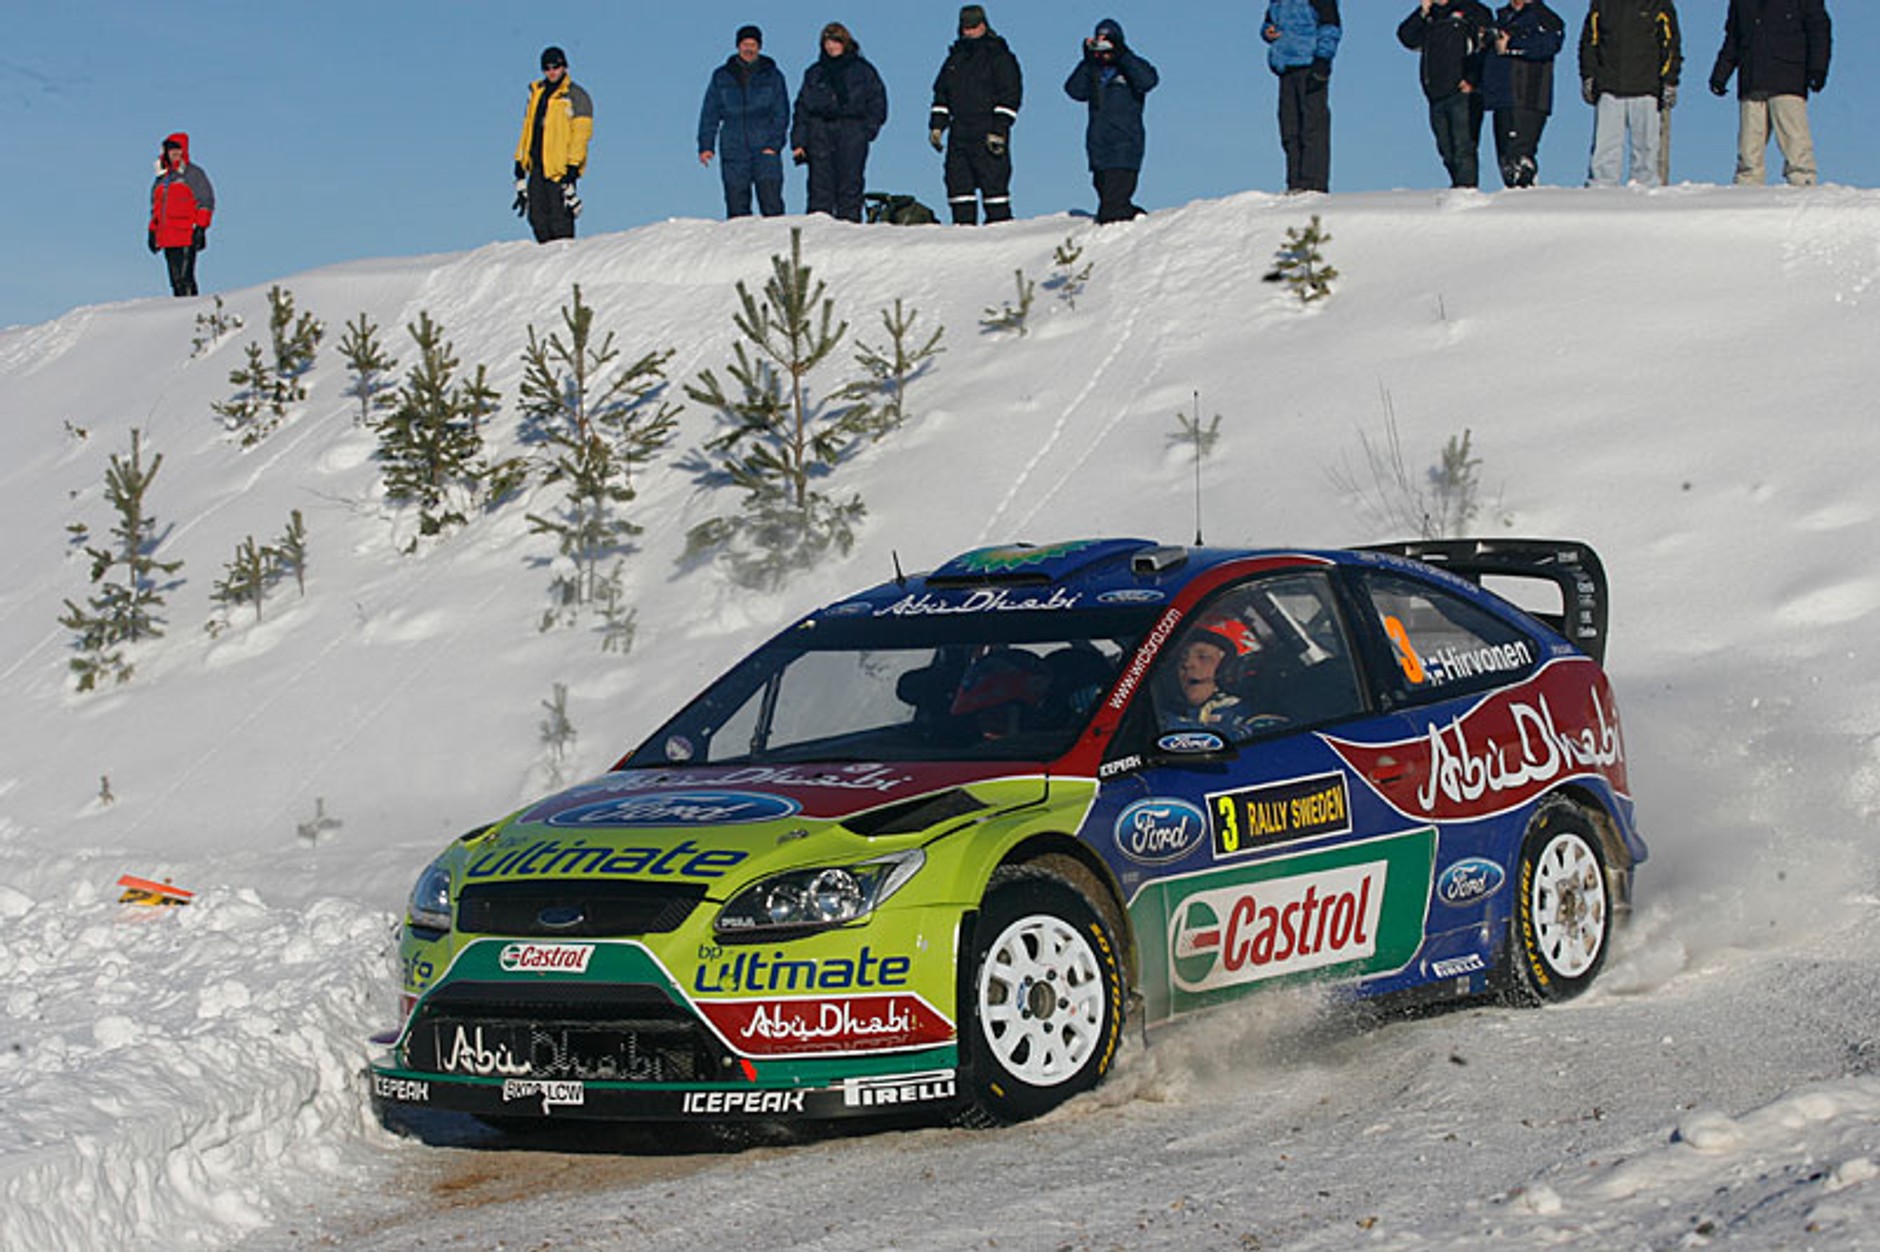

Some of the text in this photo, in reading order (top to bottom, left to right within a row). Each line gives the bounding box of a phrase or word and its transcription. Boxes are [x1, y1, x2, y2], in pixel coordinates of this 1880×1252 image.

[873, 591, 957, 617] Abu
[960, 587, 1082, 612] Dhabi
[1385, 615, 1424, 684] 3
[1437, 641, 1532, 680] Hirvonen
[1418, 685, 1623, 811] Abu Dhabi
[579, 796, 755, 821] Ford
[1218, 785, 1345, 852] 3 RALLY SWEDEN
[1132, 807, 1188, 854] Ford
[467, 840, 749, 877] ultimate
[1447, 865, 1487, 898] Ford
[1222, 875, 1371, 972] Castrol
[520, 946, 587, 968] Castrol
[694, 946, 911, 992] ultimate
[698, 944, 723, 959] bp
[741, 1000, 910, 1041] Abu Dhabi
[444, 1025, 533, 1074] Abu
[682, 1090, 805, 1112] ICEPEAK
[844, 1069, 956, 1106] PIRELLI
